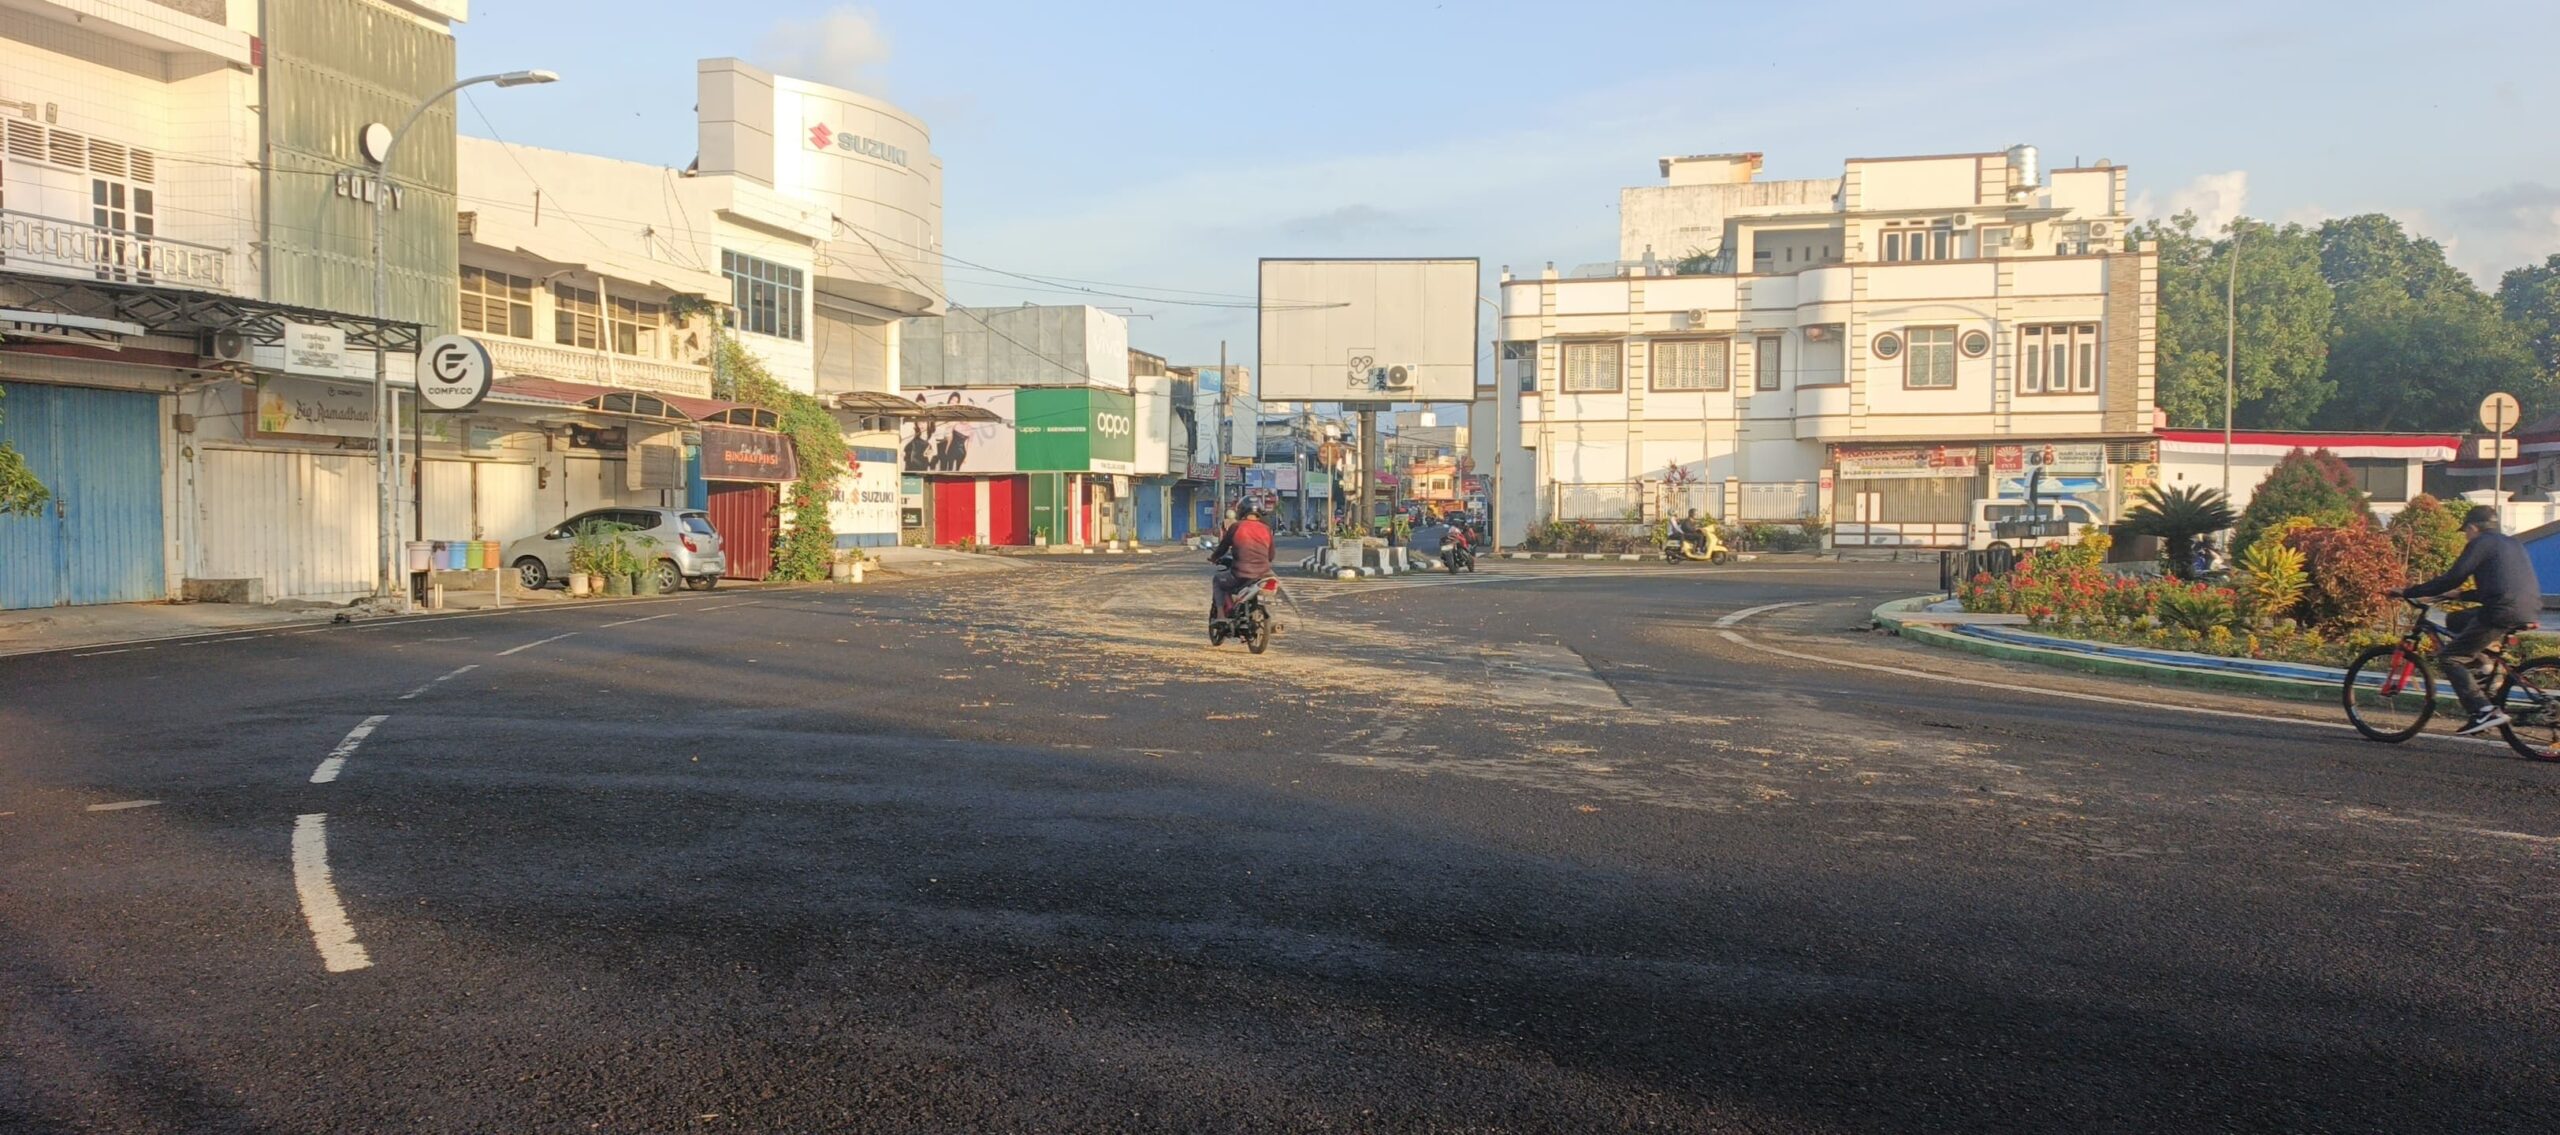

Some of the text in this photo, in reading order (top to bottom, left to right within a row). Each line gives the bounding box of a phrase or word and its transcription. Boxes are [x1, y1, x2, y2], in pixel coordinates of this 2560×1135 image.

[837, 132, 908, 167] SUZUKI
[428, 387, 473, 395] COMFY.CO
[314, 401, 369, 424] Ramadhan
[1097, 412, 1130, 439] oppo
[861, 490, 894, 503] SUZUKI
